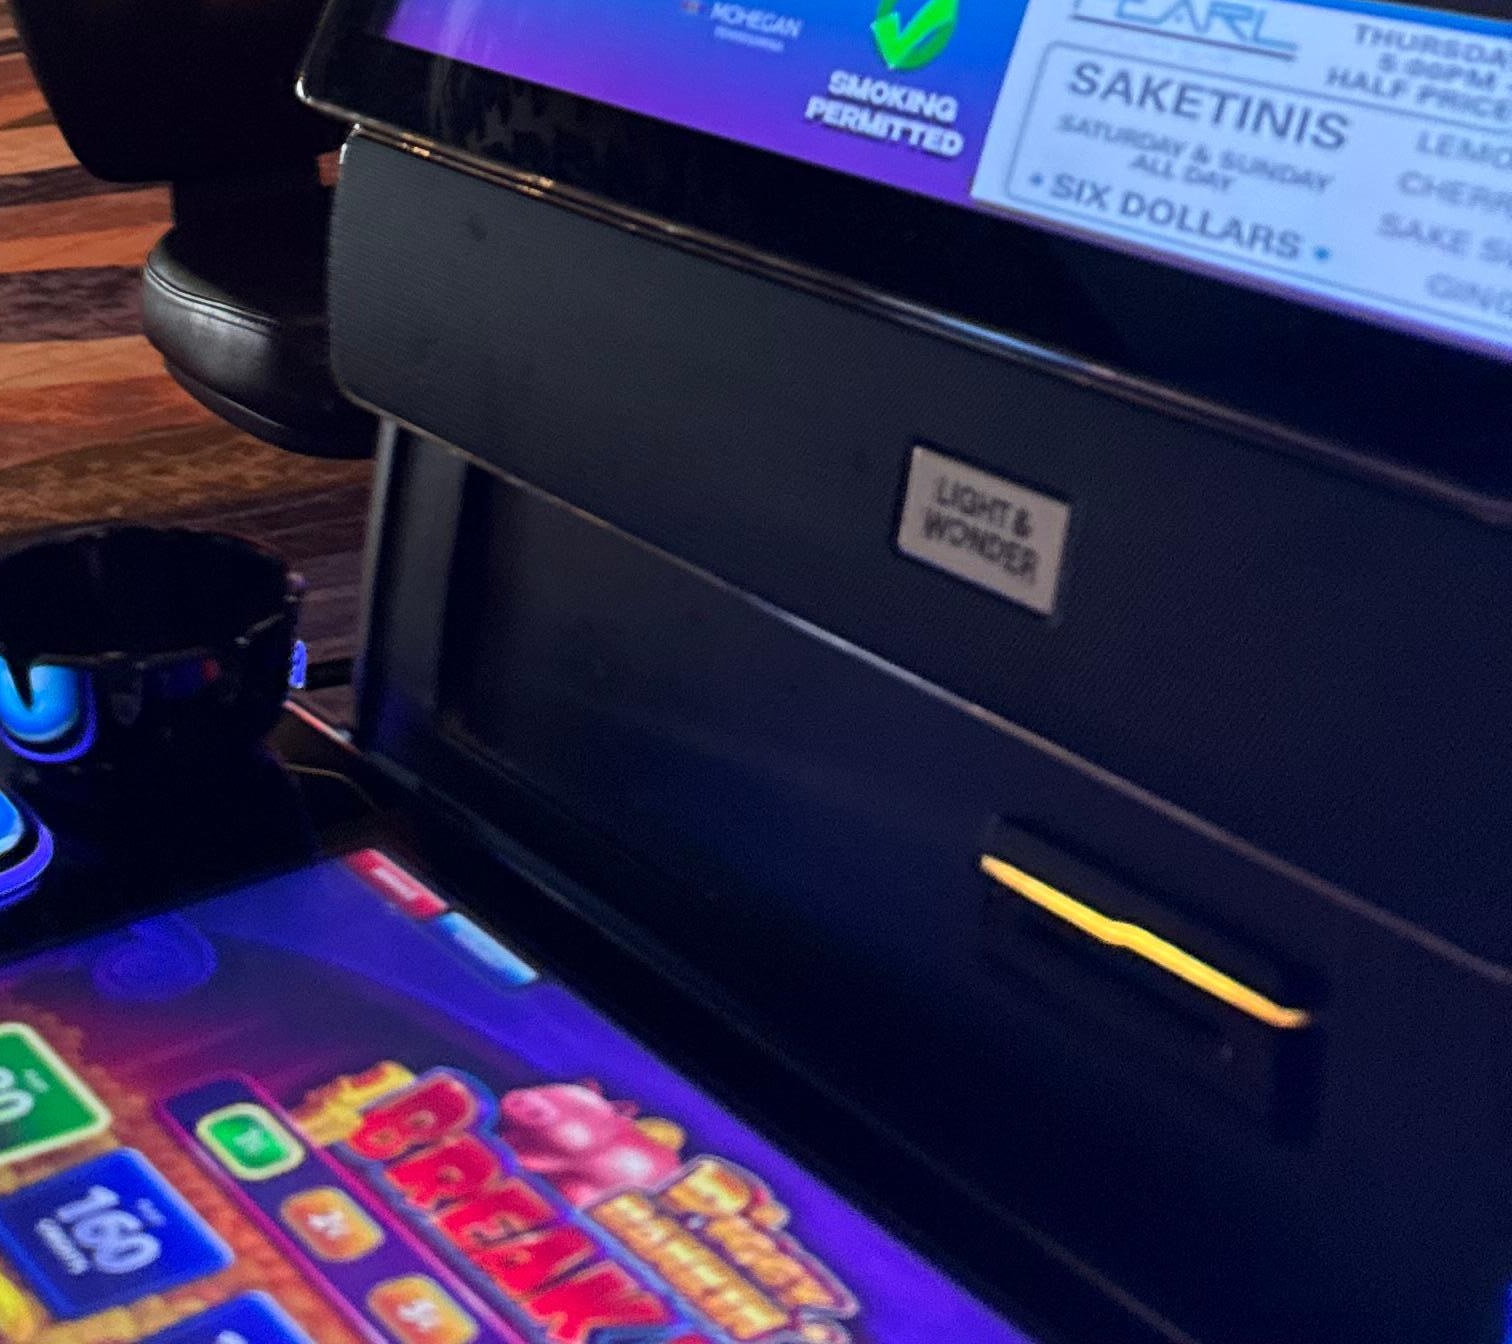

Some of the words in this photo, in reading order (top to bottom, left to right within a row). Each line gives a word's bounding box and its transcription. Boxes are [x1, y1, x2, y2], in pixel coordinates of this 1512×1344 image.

[805, 95, 965, 157] PERMITTED
[828, 70, 958, 123] SMOKING
[1069, 61, 1351, 152] SAKETINIS
[1058, 113, 1187, 159] SATURDAY
[1221, 149, 1333, 194] SUNDAY
[1131, 155, 1174, 181] ALL
[1183, 164, 1234, 192] DAY
[1050, 172, 1111, 210] SIX
[1120, 191, 1302, 259] DOLLARS
[934, 475, 1012, 522] LIGHT
[1012, 509, 1032, 538] &
[923, 509, 1040, 584] WONDER
